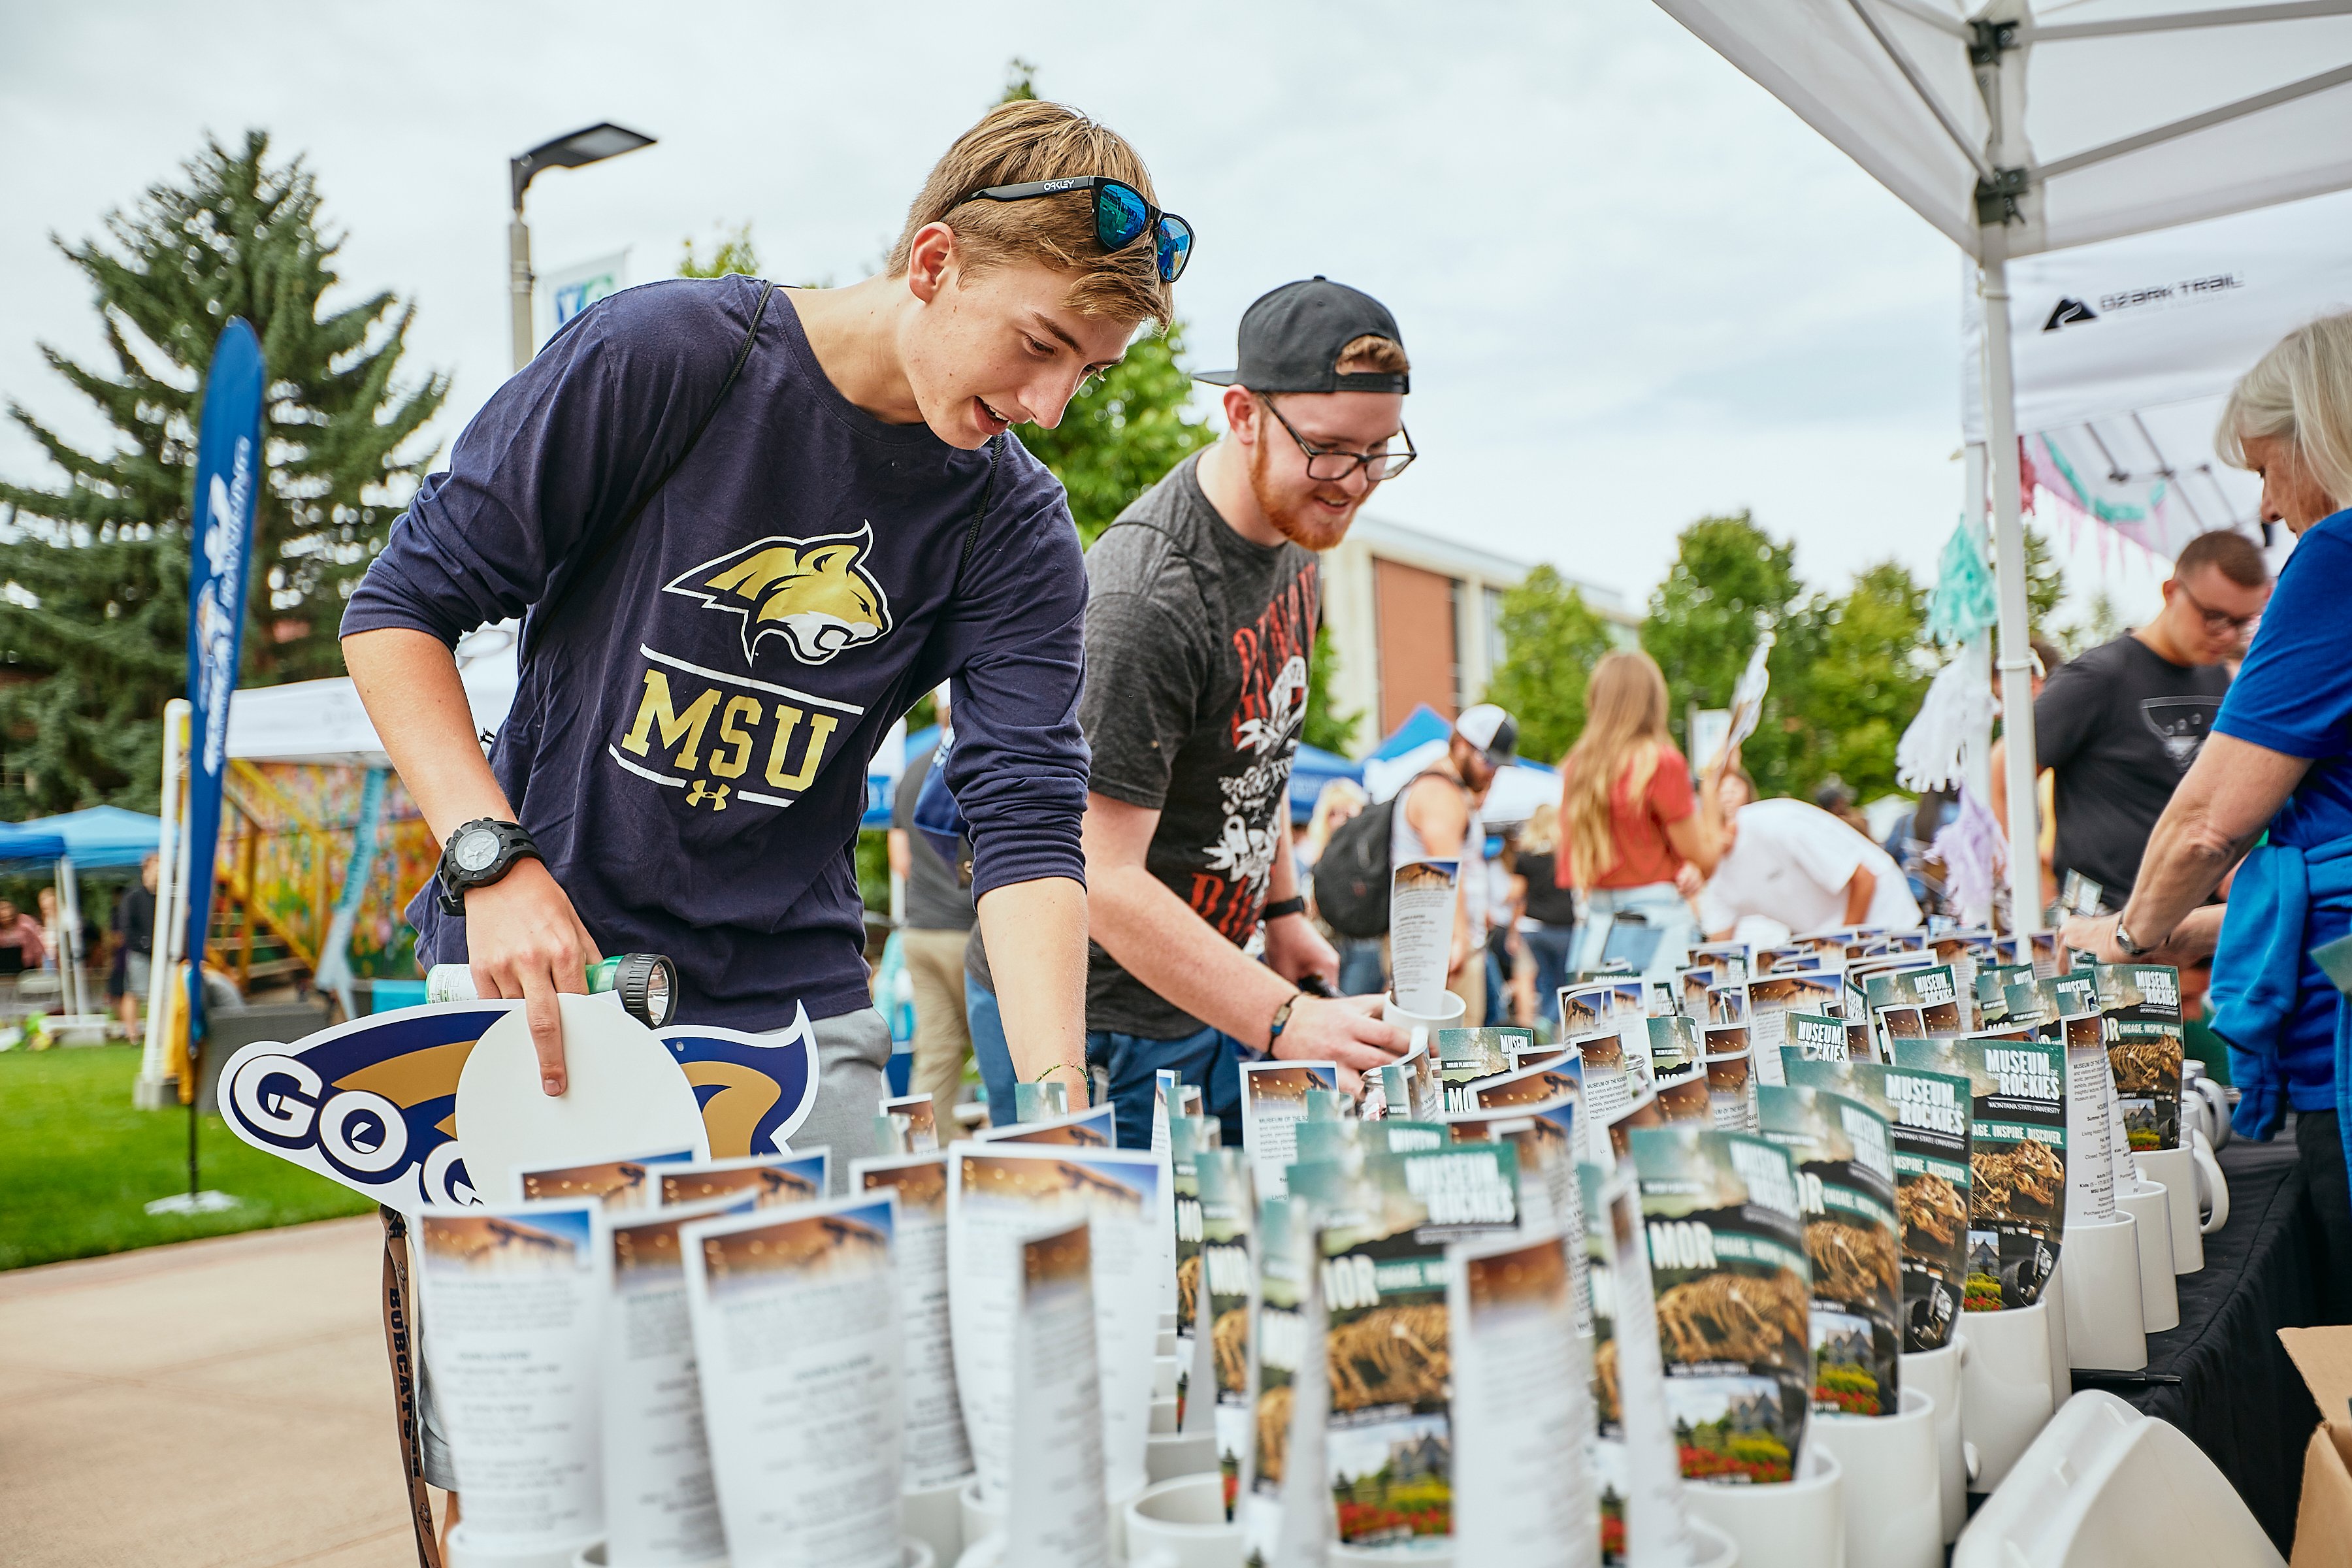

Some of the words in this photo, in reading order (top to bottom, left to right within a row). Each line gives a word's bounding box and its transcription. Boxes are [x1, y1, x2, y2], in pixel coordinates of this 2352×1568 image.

[1043, 179, 1075, 191] OAKLEY
[2100, 285, 2174, 312] OZARK
[2179, 273, 2245, 295] TRAIL
[621, 668, 838, 792] MSU
[1798, 1021, 1842, 1045] MUSEUM
[1805, 1041, 1846, 1062] CKIES
[1985, 1048, 2050, 1077] MUSEUM
[1886, 1073, 1955, 1109] MUSEUM
[1987, 1072, 2000, 1081] THE
[1999, 1072, 2061, 1100] ROCKIES
[1900, 1100, 1966, 1137] ROCKIES
[1987, 1101, 2017, 1111] MONTANA
[1992, 1124, 2027, 1140] INSPIRE.
[2027, 1128, 2064, 1145] DISCOVER.
[1927, 1160, 1967, 1184] DISCOVER.
